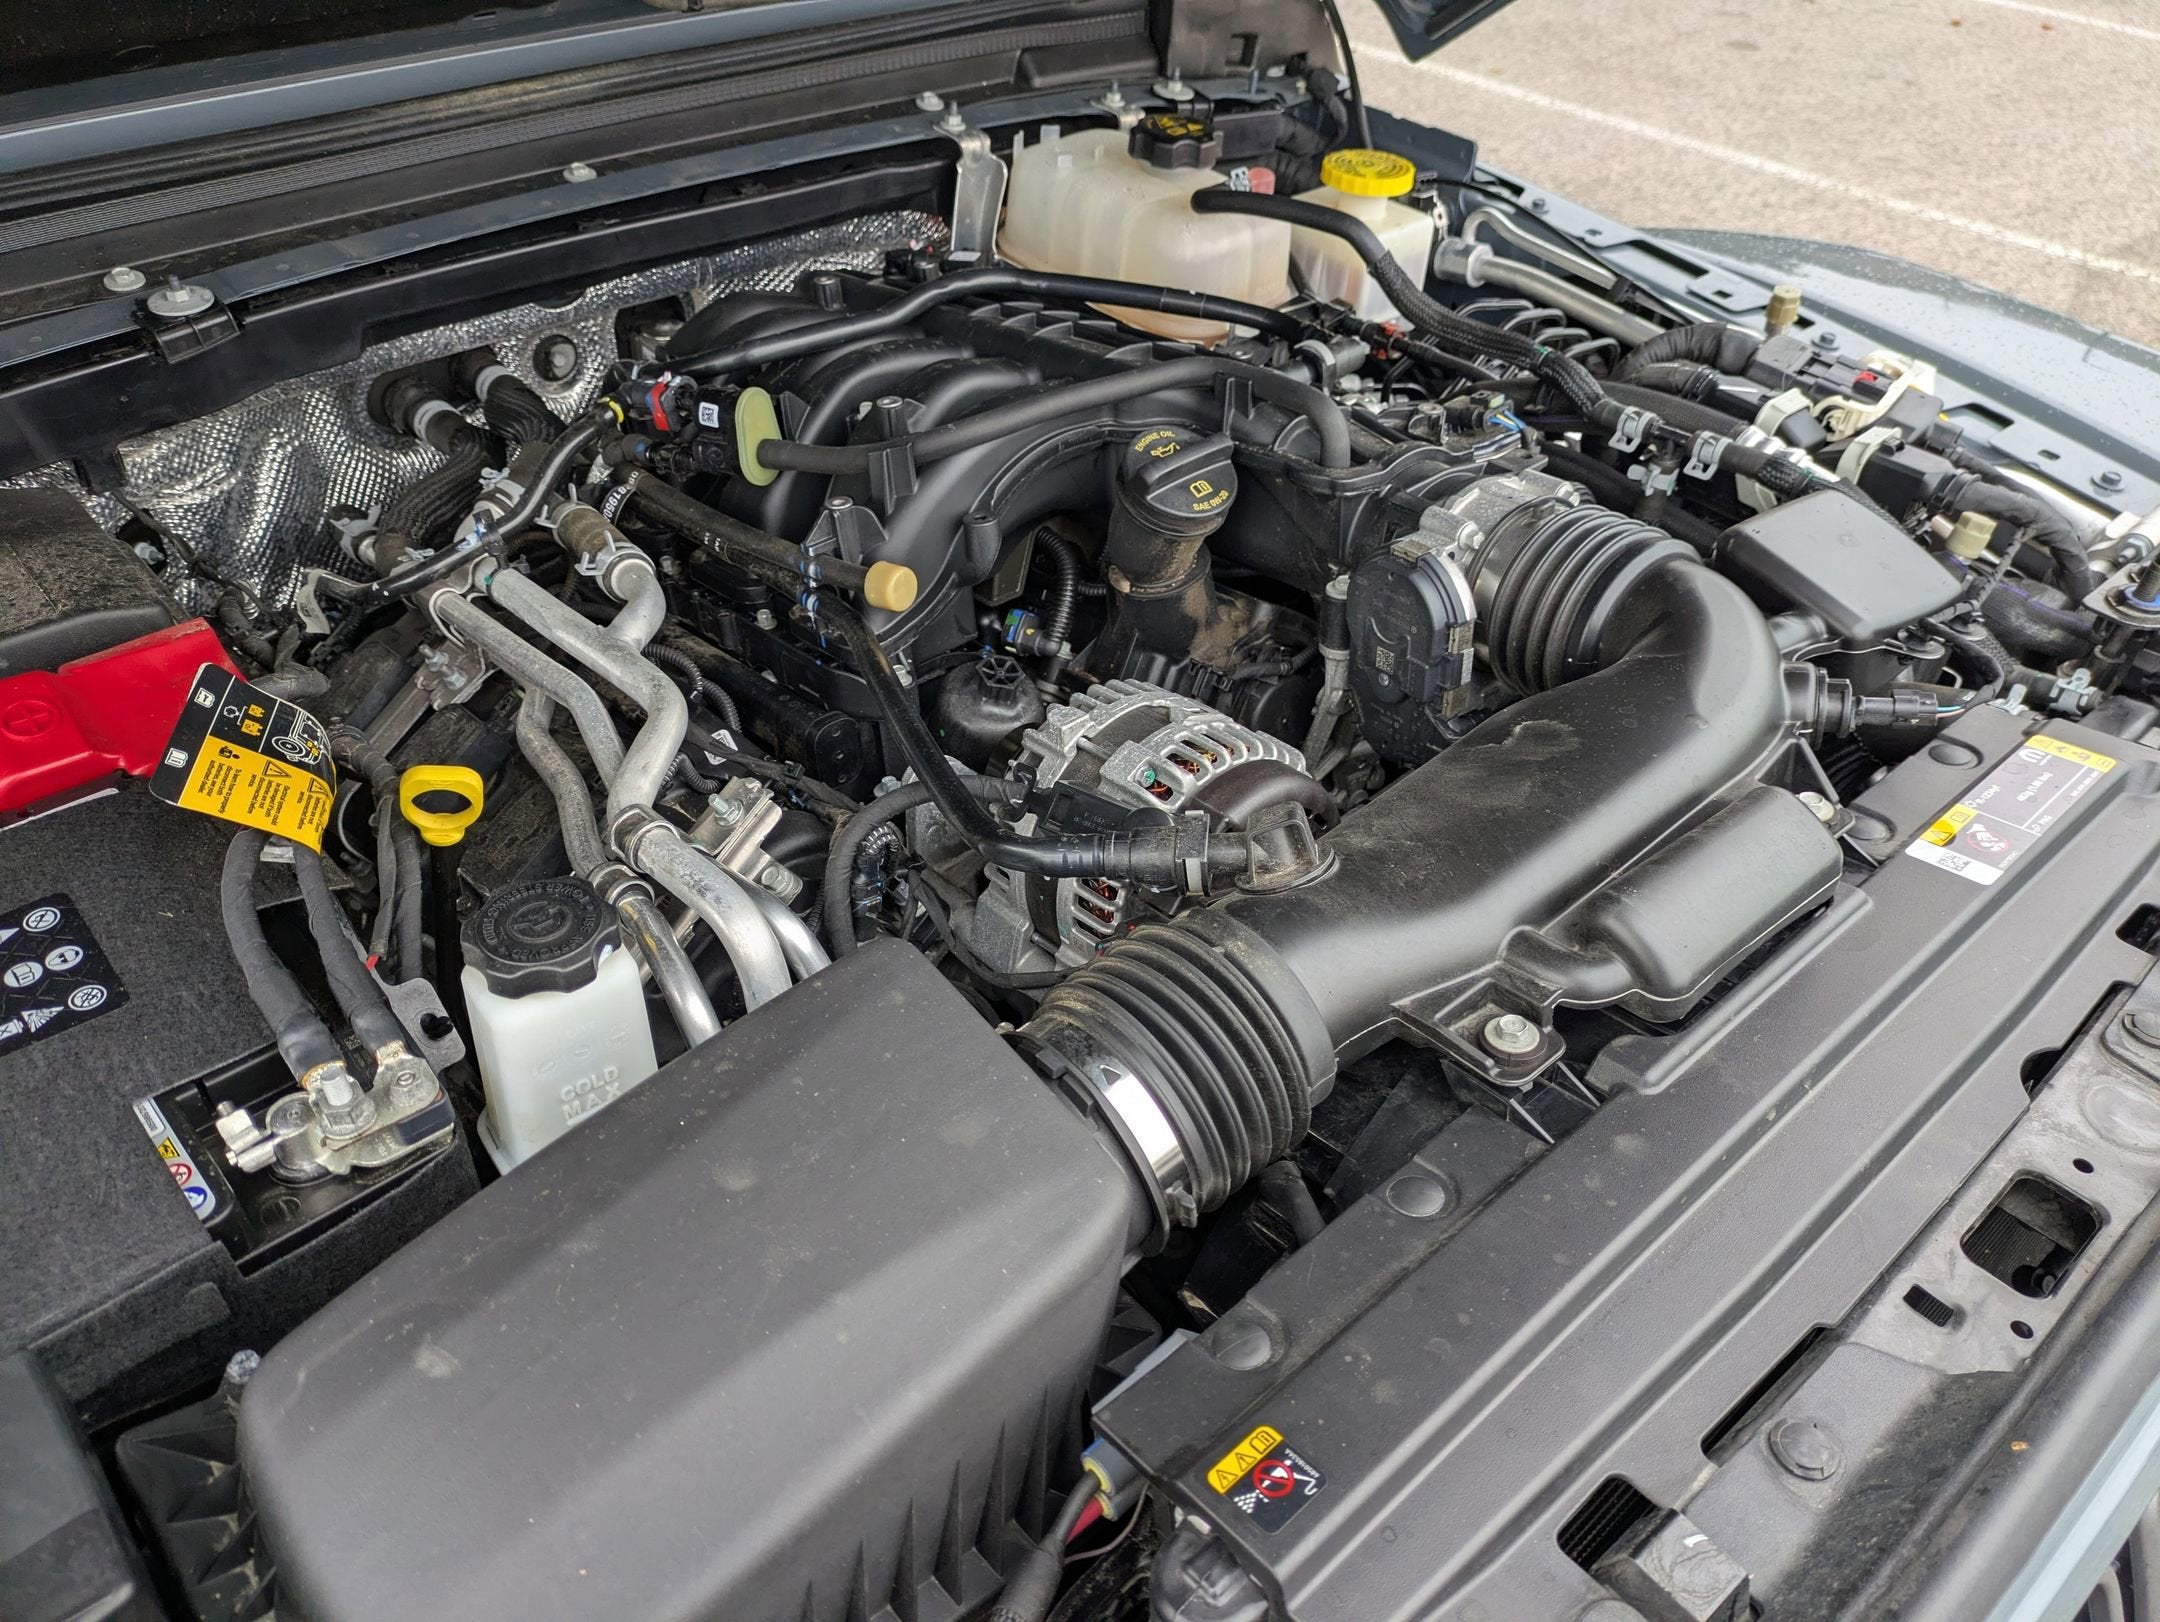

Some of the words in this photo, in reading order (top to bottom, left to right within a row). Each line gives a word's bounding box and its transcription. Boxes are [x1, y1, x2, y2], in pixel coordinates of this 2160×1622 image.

[1135, 431, 1160, 452] ENGINE
[1193, 501, 1211, 511] SAE
[1209, 490, 1229, 505] 0W-20
[221, 765, 232, 786] disconnect
[231, 773, 239, 782] learn
[216, 786, 224, 795] both
[252, 777, 264, 800] disconnected
[268, 787, 279, 804] damaged
[218, 796, 229, 813] properly
[247, 801, 255, 813] before
[486, 881, 543, 919] STEERING
[546, 881, 590, 903] POWER
[481, 917, 498, 945] FLUID
[579, 913, 597, 934] USE
[510, 934, 584, 962] APPROVED
[560, 1064, 620, 1102] COLD
[561, 1081, 622, 1120] MAX
